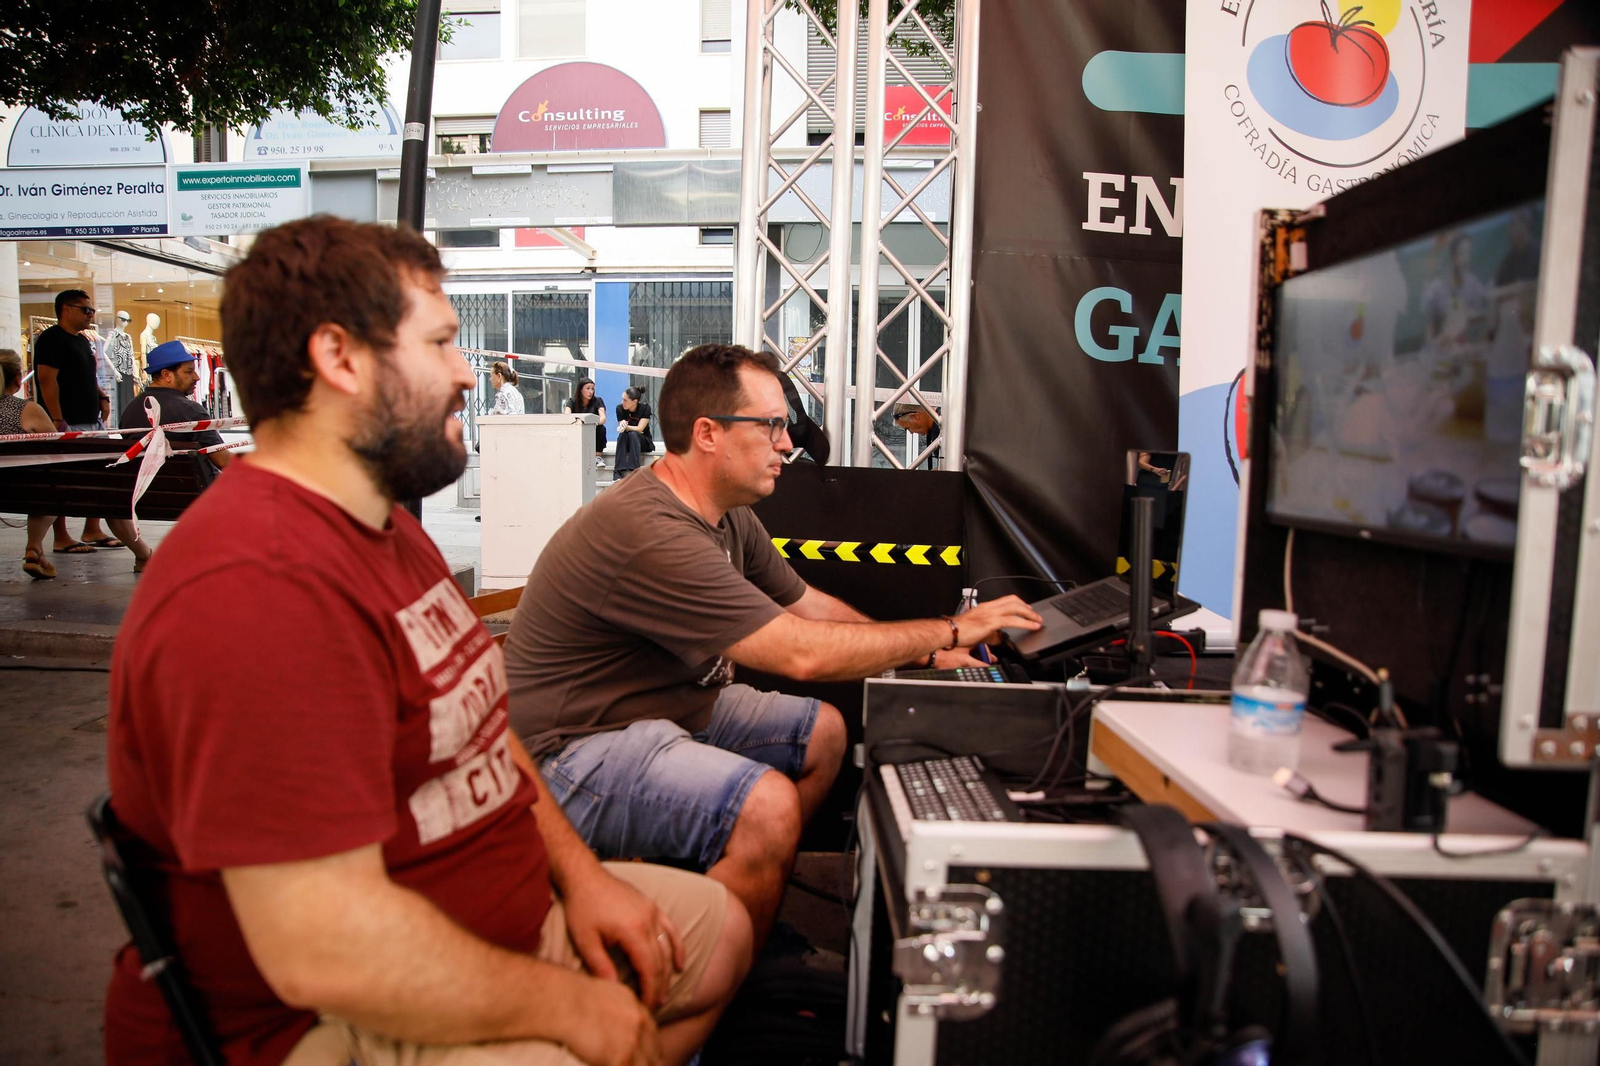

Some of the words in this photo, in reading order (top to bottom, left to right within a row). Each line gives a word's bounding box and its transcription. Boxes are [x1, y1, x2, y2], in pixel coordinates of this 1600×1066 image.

[518, 104, 626, 123] Consulting
[30, 123, 84, 138] CLÍNICA
[87, 123, 141, 137] DENTAL
[544, 123, 580, 131] SERVICIOS
[582, 121, 639, 130] EMPRESARIALES
[1224, 84, 1299, 185] COFRADÍA
[182, 173, 296, 186] www.expertoinmobiliario.com
[18, 183, 47, 197] Iván
[51, 182, 113, 197] Giménez
[117, 181, 165, 195] Peralta
[200, 193, 232, 201] SERVICIOS
[232, 191, 279, 200] INMOBILIARIOS
[232, 201, 272, 209] PATRIMONIAL
[1082, 171, 1184, 238] EN
[8, 211, 59, 222] Ginecología
[60, 212, 66, 220] y
[67, 209, 125, 221] Reproducción
[127, 208, 158, 218] Asistida
[75, 227, 88, 235] 950
[89, 227, 100, 235] 251
[102, 226, 115, 234] 998
[140, 225, 160, 233] Planta
[1074, 286, 1181, 367] GA
